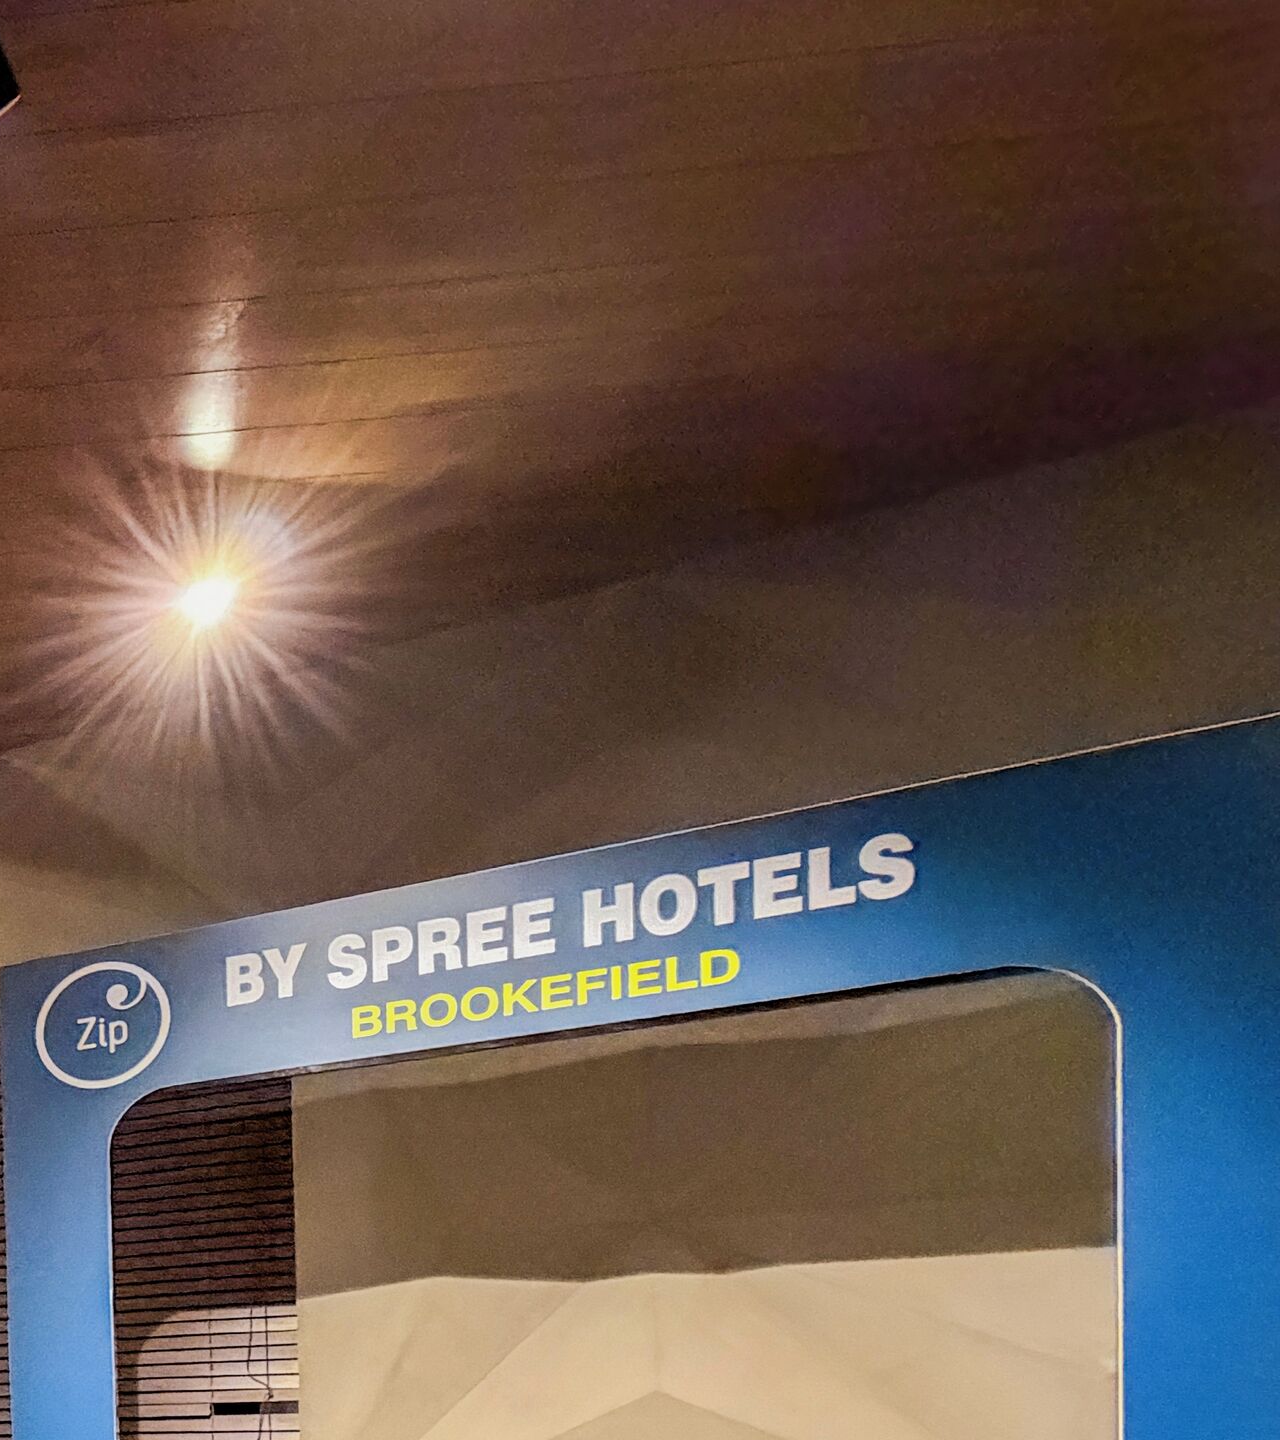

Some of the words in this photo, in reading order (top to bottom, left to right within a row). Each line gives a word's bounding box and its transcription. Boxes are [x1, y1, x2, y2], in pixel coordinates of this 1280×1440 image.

[225, 942, 308, 1008] BY
[326, 897, 556, 990] SPREE
[582, 832, 916, 949] HOTELS
[75, 1016, 129, 1054] Zip
[351, 948, 740, 1039] BROOKEFIELD
